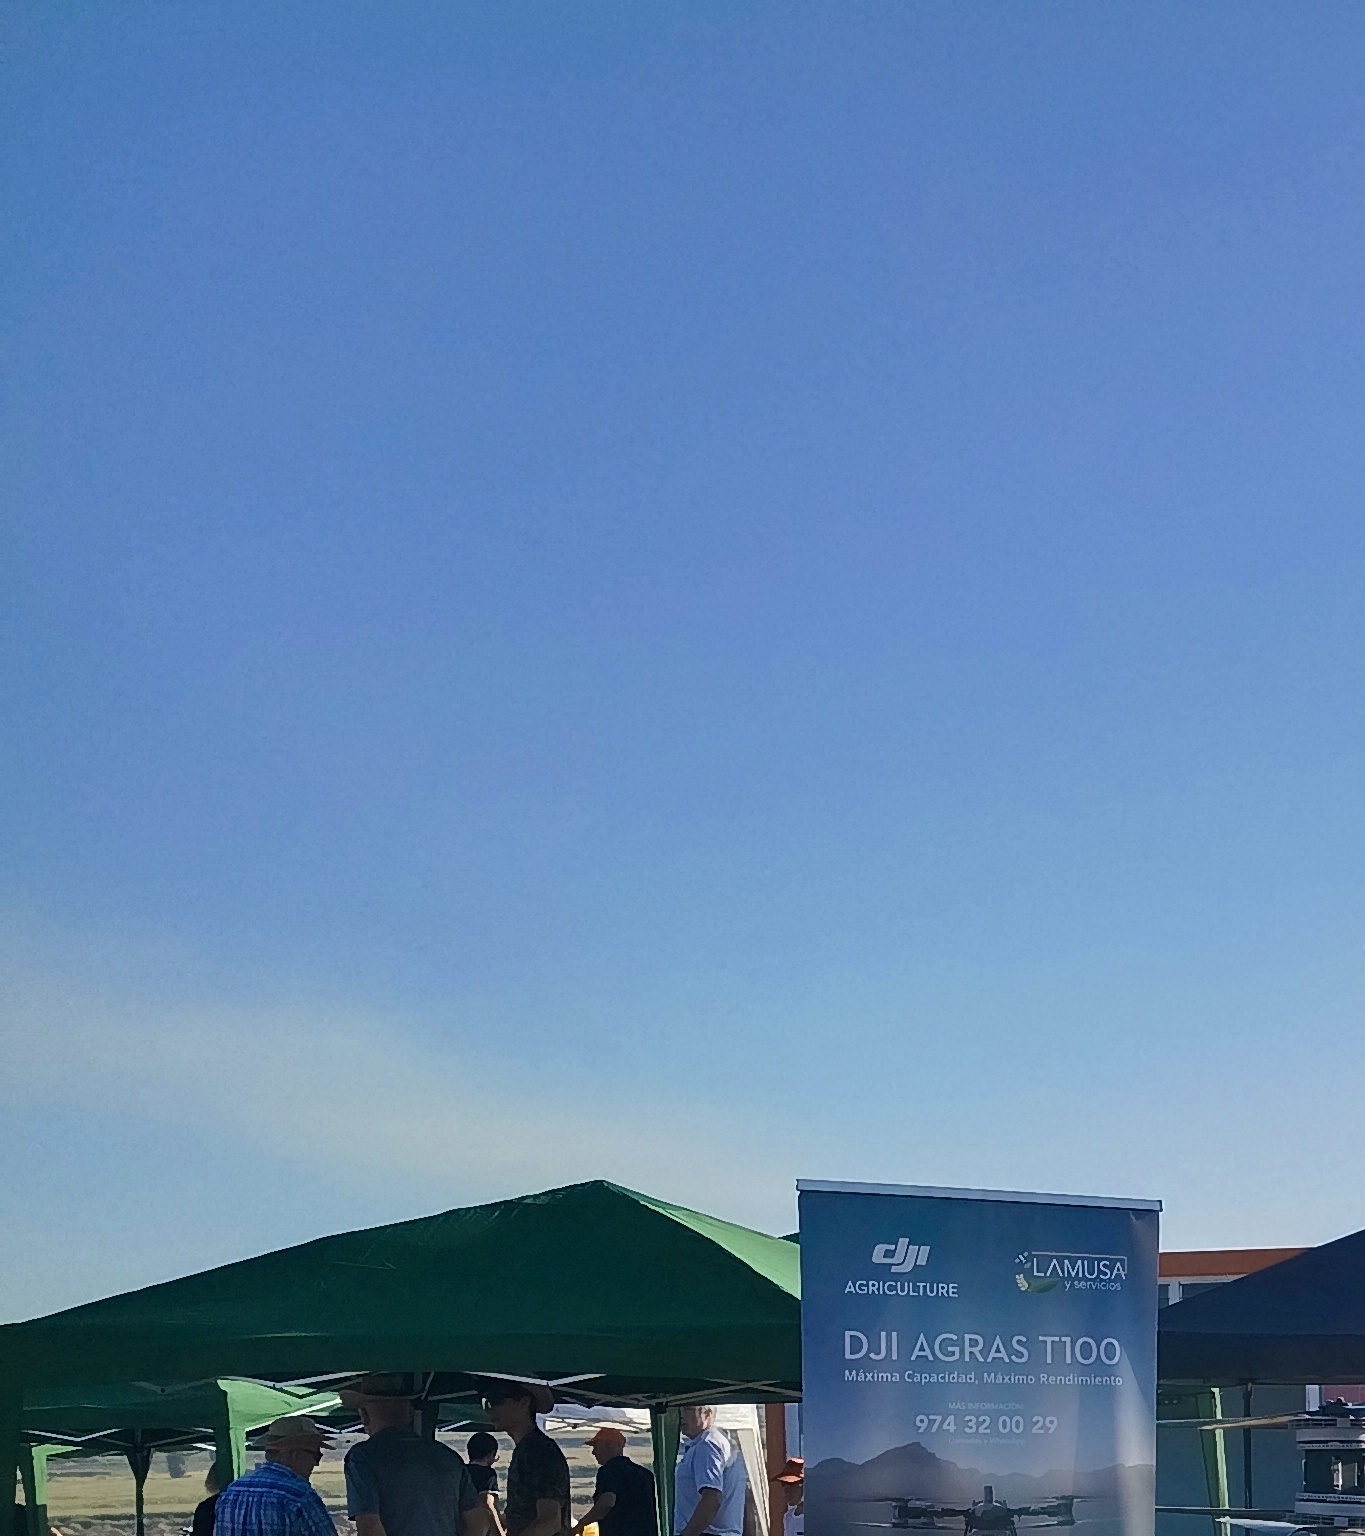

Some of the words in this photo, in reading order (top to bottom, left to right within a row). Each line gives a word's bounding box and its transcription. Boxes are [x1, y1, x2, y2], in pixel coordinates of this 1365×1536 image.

[1033, 1256, 1126, 1280] LAMUSA
[845, 1281, 958, 1297] AGRICULTURE
[1064, 1281, 1071, 1291] y
[1074, 1280, 1121, 1291] servicios
[844, 1331, 898, 1361] DJI
[911, 1333, 1029, 1363] AGRAS
[1039, 1336, 1121, 1365] T100
[844, 1369, 899, 1383] Máxima
[905, 1371, 979, 1386] Capacidad,
[983, 1372, 1035, 1384] Máximo
[1040, 1373, 1123, 1386] Rendimiento
[915, 1415, 956, 1433] 974
[964, 1415, 991, 1434] 32
[998, 1415, 1024, 1434] 00
[1031, 1416, 1058, 1434] 29
